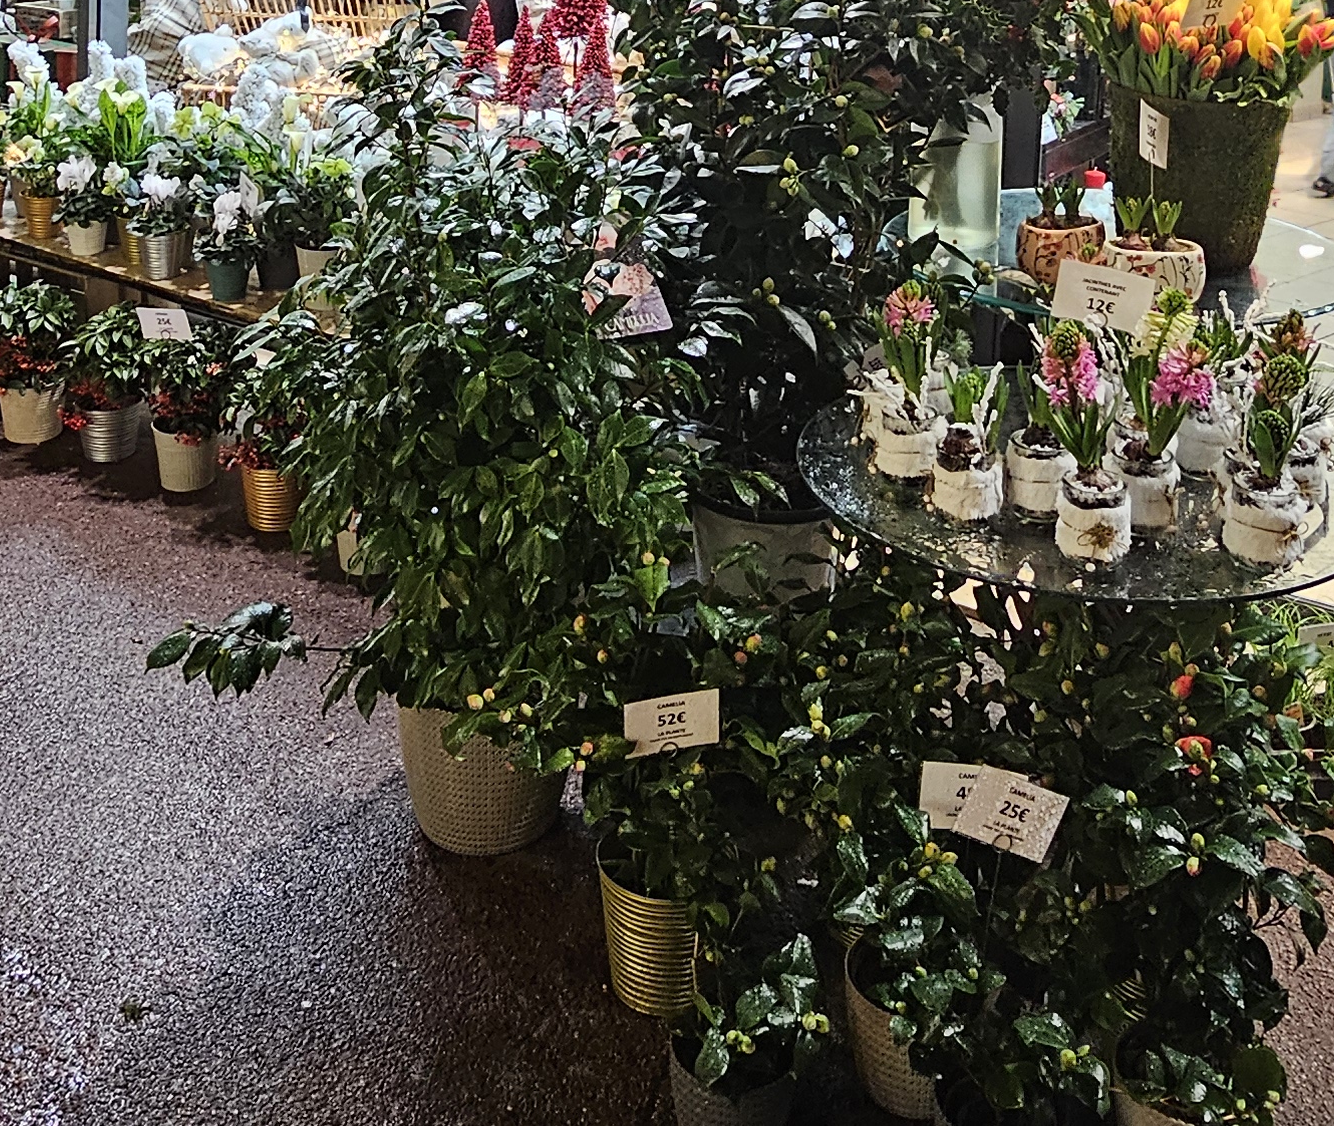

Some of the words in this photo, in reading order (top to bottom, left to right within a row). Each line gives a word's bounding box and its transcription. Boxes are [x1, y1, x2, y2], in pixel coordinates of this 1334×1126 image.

[1086, 297, 1117, 315] 12€
[657, 711, 687, 727] 52€
[999, 800, 1031, 823] 25€
